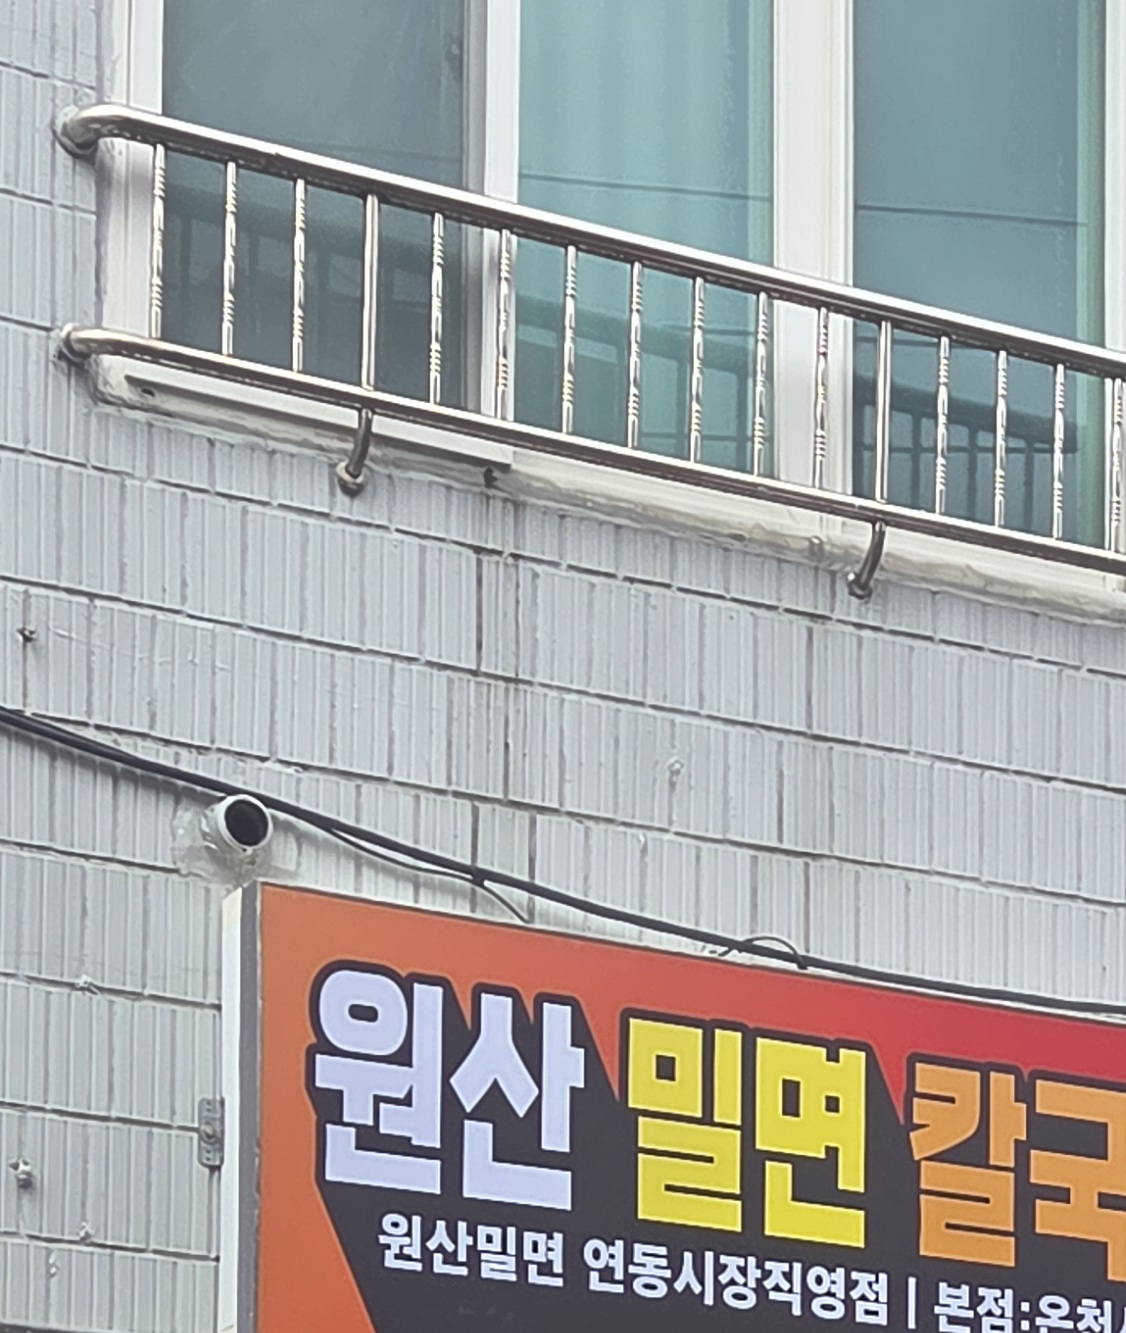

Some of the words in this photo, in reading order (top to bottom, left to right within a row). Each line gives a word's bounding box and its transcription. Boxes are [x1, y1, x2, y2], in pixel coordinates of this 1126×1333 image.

[313, 968, 586, 1211] 원산
[626, 1017, 867, 1248] 밀면
[379, 1214, 564, 1290] 원산밀면
[584, 1242, 889, 1328] 연동시장직영점
